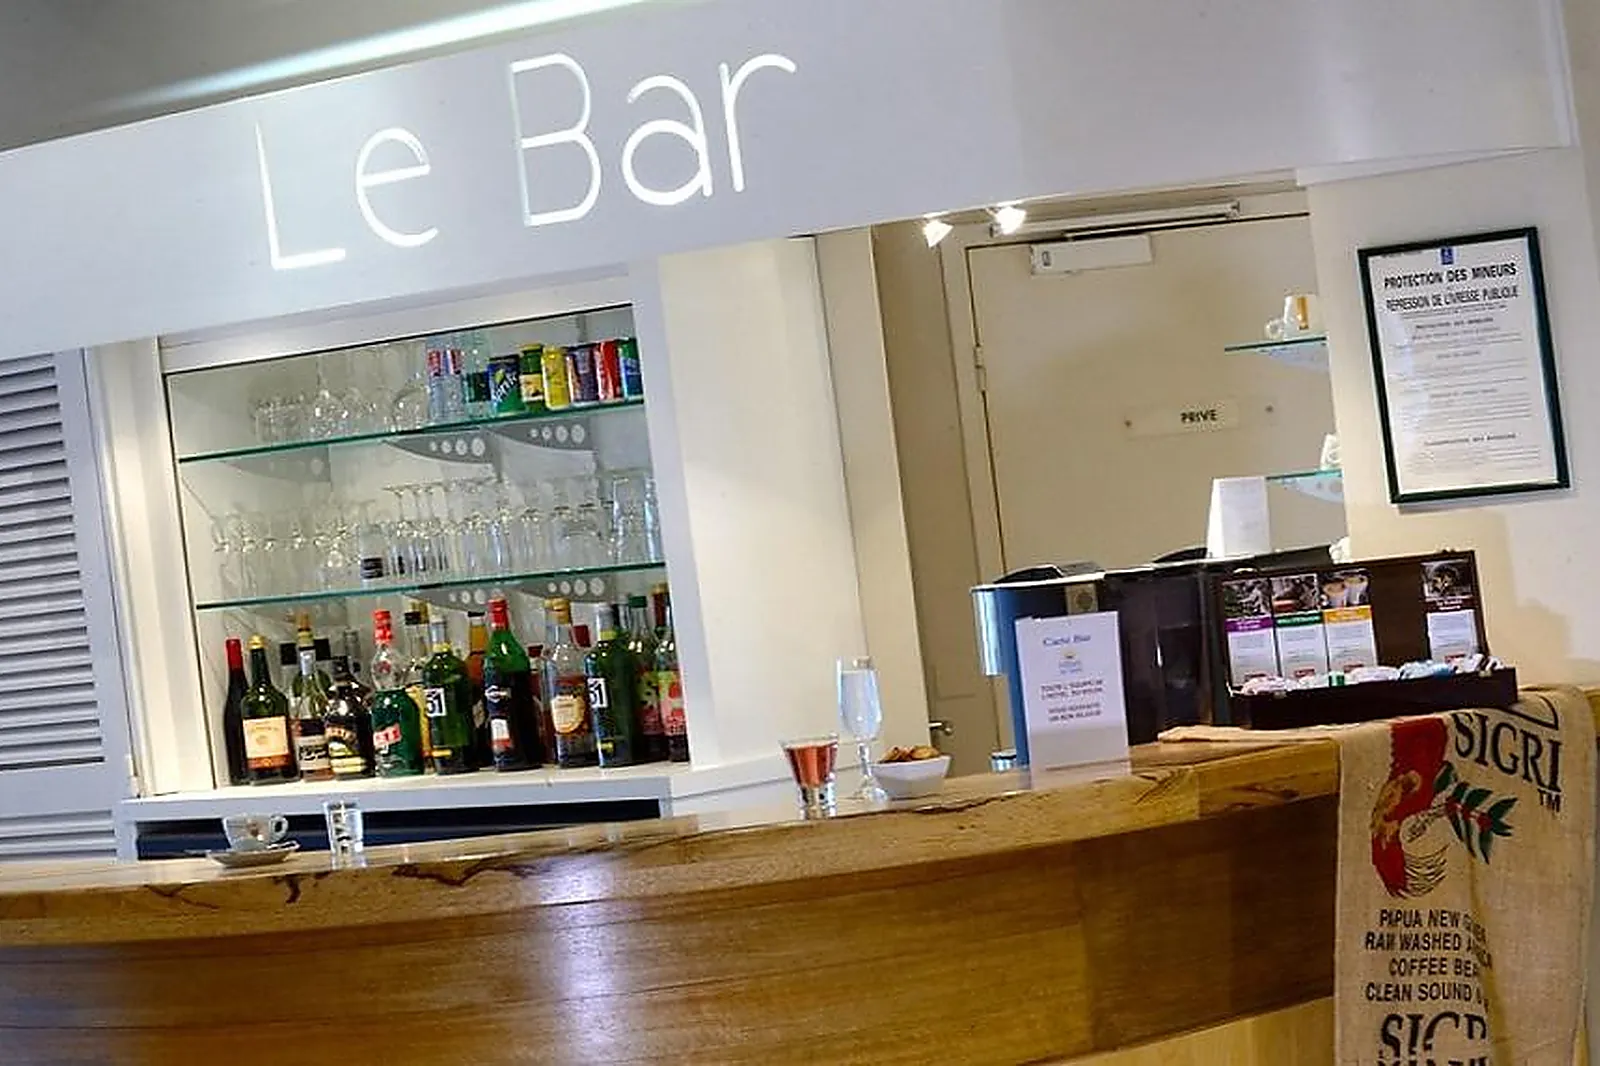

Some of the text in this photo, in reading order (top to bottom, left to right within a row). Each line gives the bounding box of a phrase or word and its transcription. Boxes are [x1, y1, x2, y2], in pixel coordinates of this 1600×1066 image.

[255, 52, 797, 271] Le Bar
[1384, 262, 1517, 289] PROTECTION DES MINEURS
[1451, 711, 1562, 793] SIGRI
[1379, 909, 1422, 927] PAPUA
[1427, 909, 1460, 928] NEW
[1365, 931, 1461, 951] RAW WASHED
[1389, 957, 1448, 976] COFFEE
[1365, 982, 1412, 1001] CLEAN
[1418, 982, 1472, 1001] SOUND
